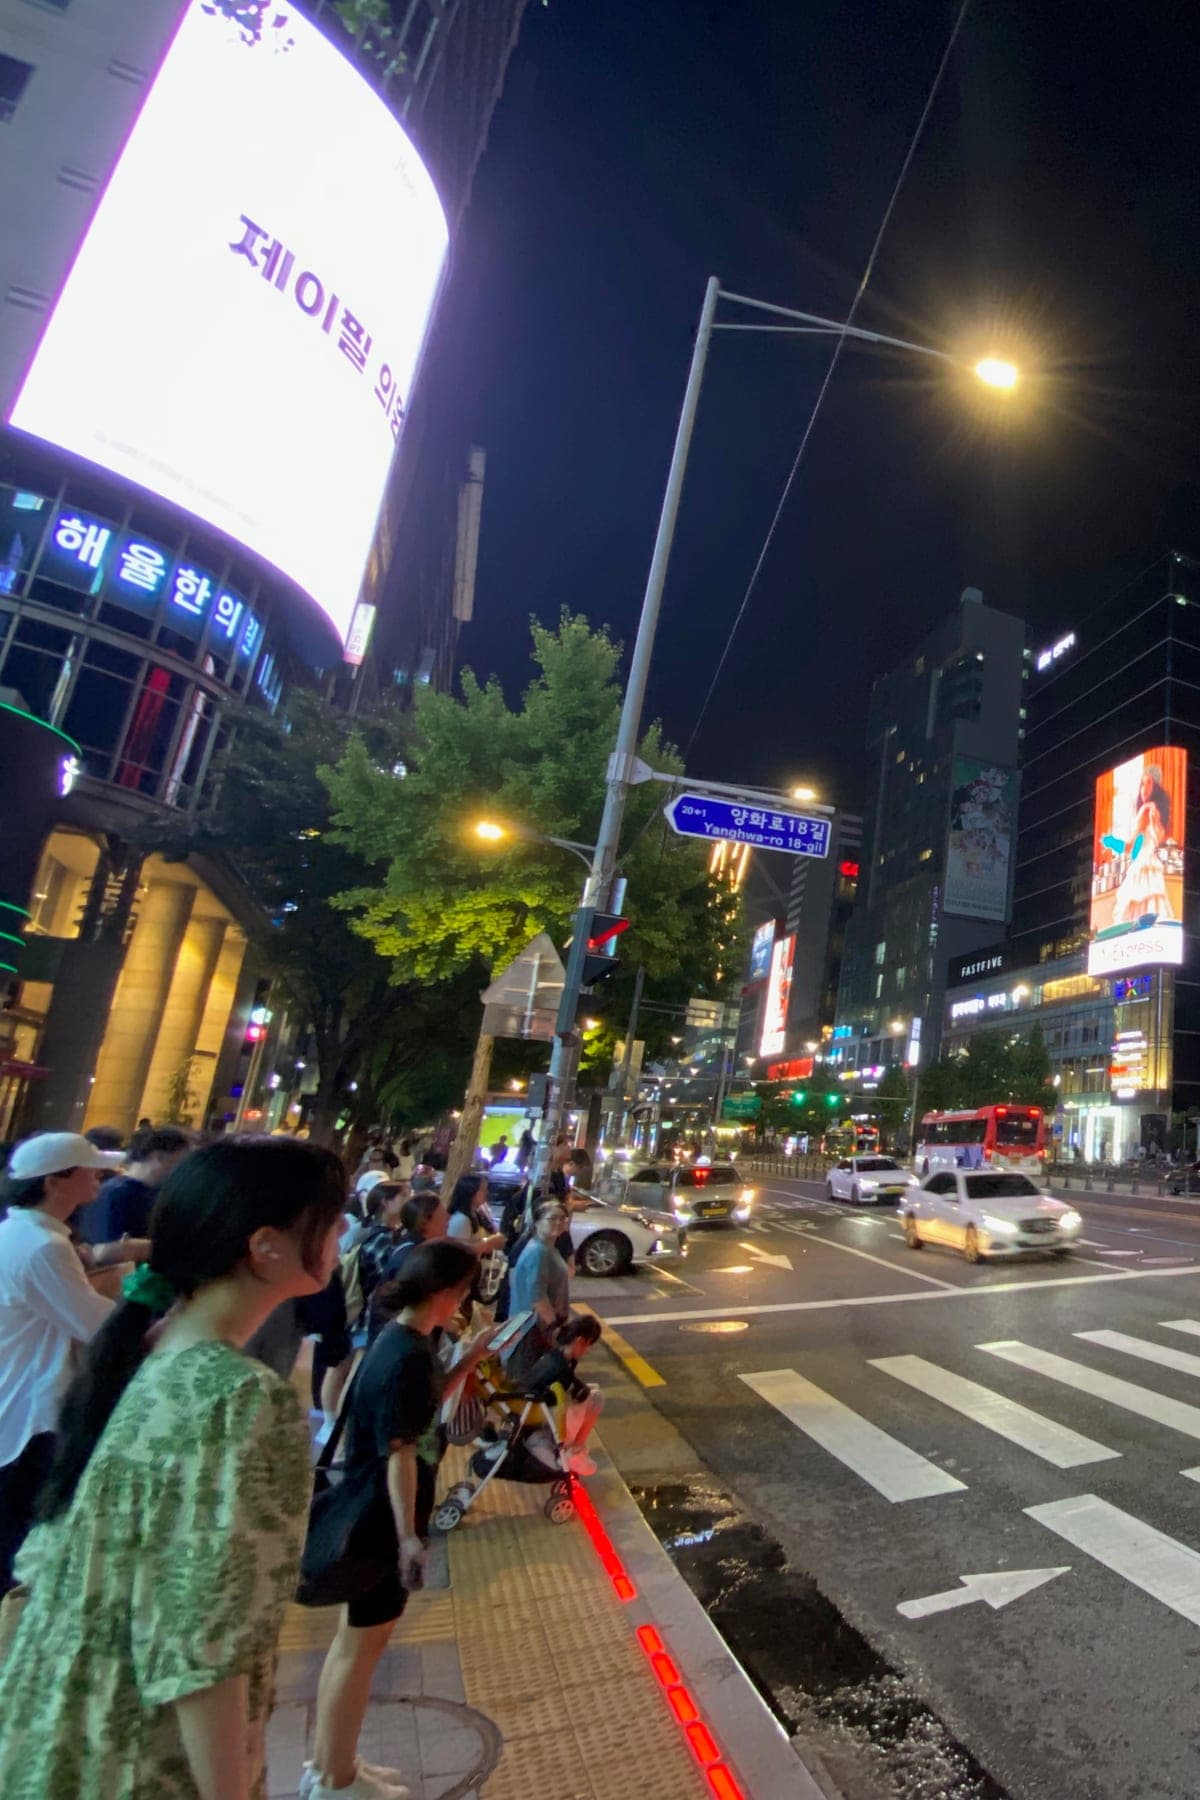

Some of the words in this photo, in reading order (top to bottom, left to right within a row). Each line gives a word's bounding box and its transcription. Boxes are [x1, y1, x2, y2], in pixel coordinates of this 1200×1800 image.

[229, 213, 373, 374] 제이필
[704, 822, 784, 846] Yanghwa-ro
[787, 837, 822, 853] 18-gil
[730, 807, 825, 841] 양화로18길
[961, 955, 1003, 977] FASTFIVE
